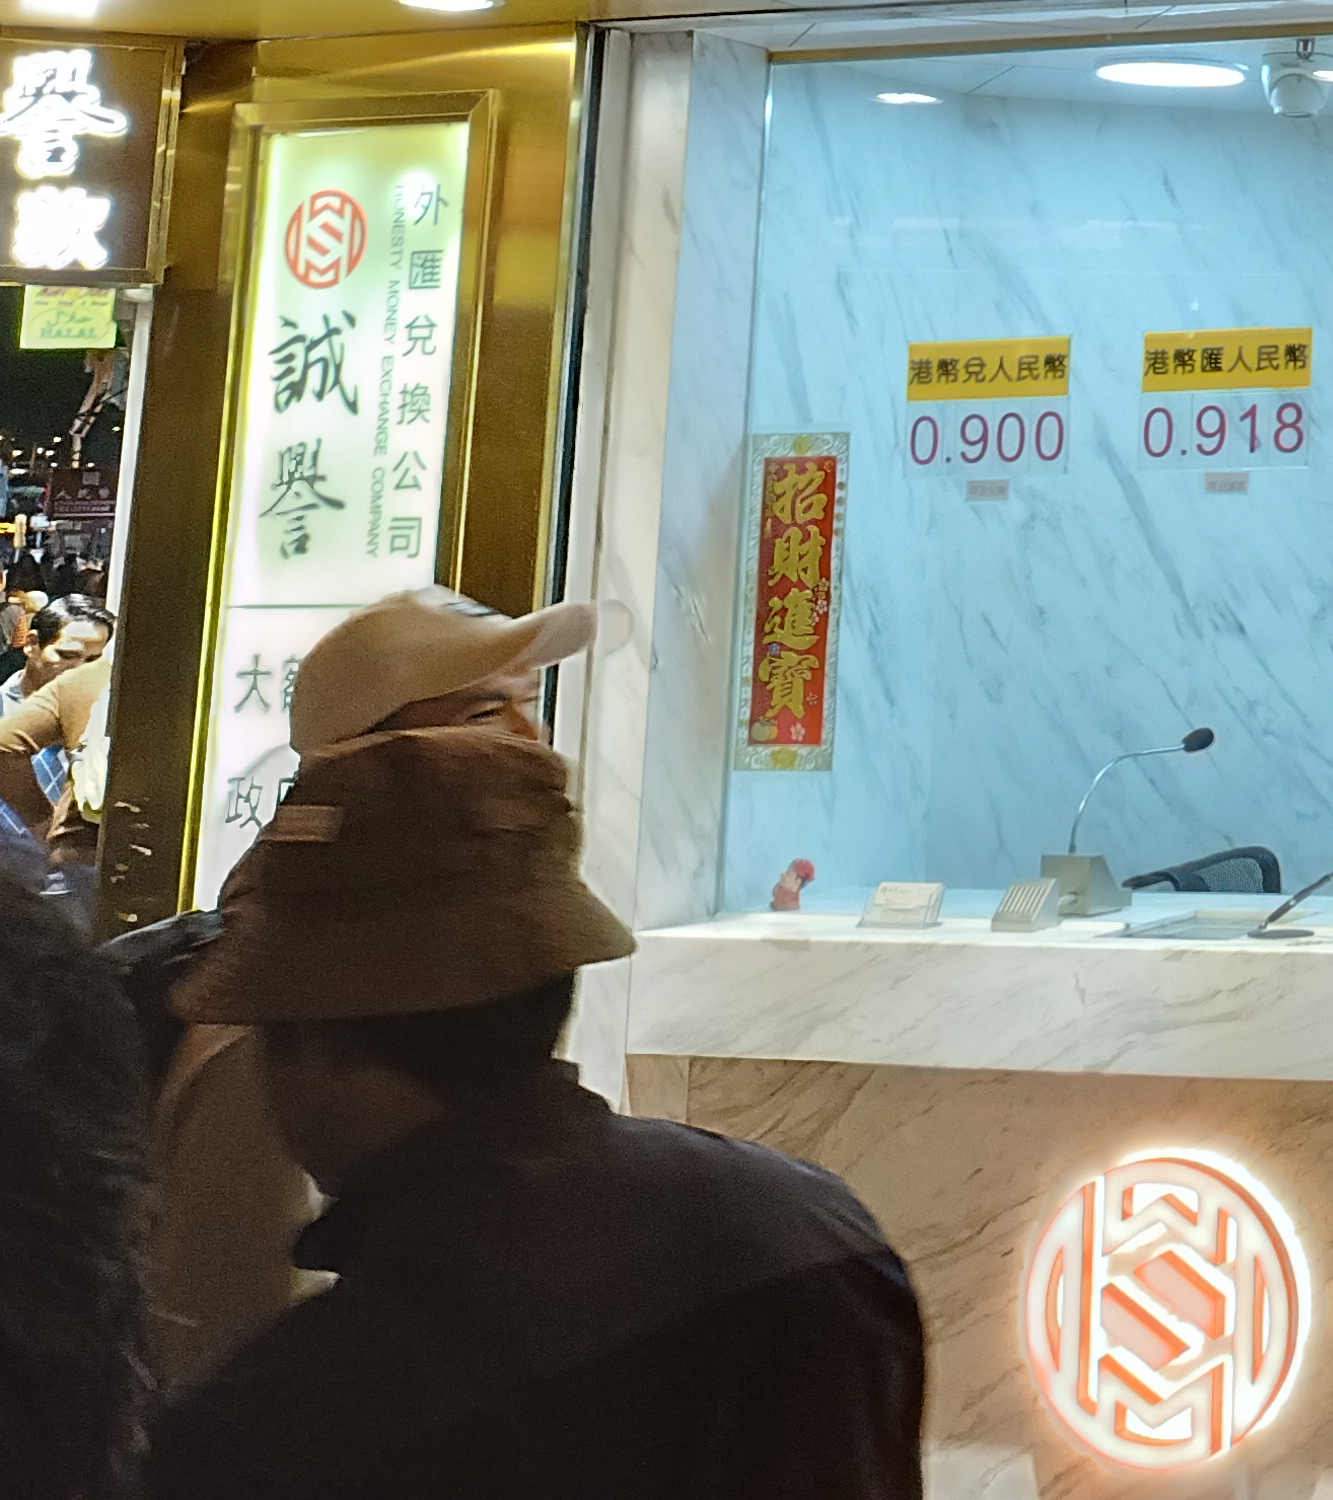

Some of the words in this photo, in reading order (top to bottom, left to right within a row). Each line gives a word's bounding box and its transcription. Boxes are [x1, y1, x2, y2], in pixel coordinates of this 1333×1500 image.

[384, 185, 406, 270] HONESTY
[382, 279, 400, 345] MONEY
[258, 308, 360, 560] 誠譽
[372, 355, 395, 456] EXCHANGE
[910, 411, 1064, 465] 0.900
[1142, 402, 1306, 459] 0.918
[366, 466, 387, 558] COMPANY
[757, 461, 829, 721] 招財進寶
